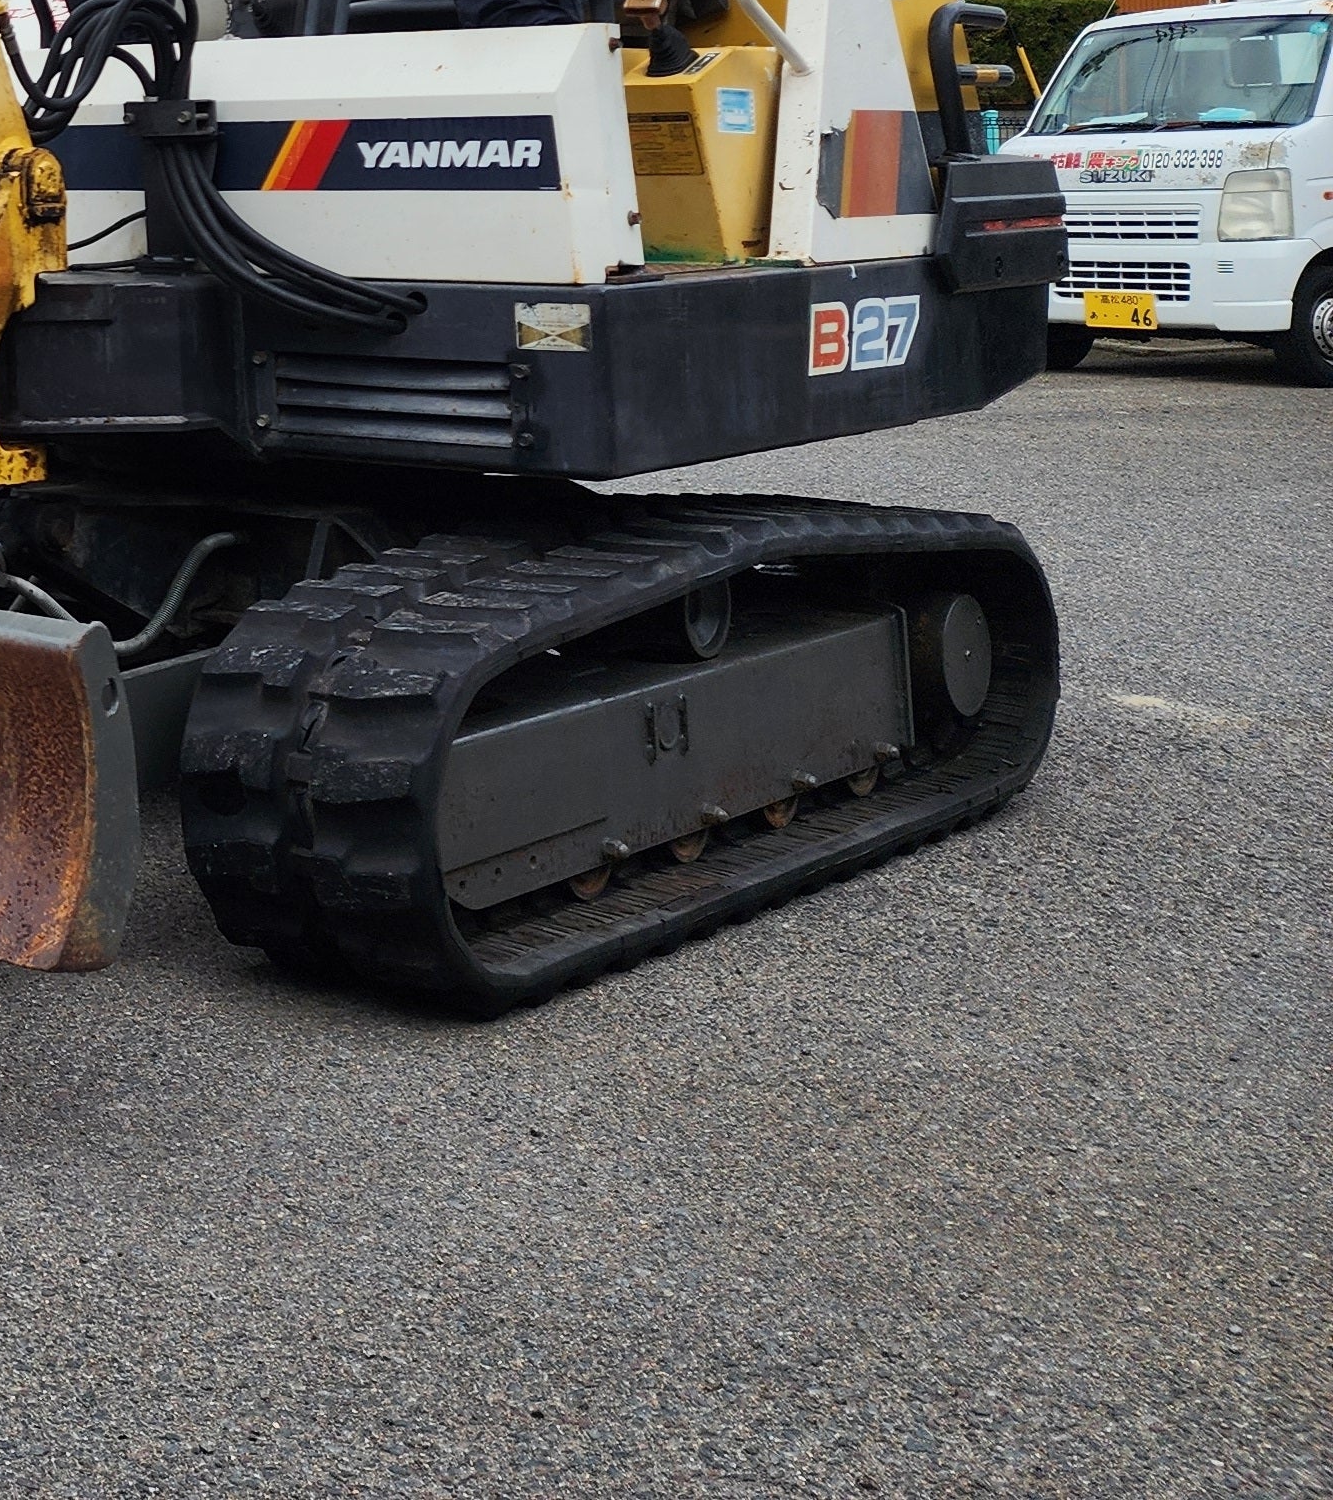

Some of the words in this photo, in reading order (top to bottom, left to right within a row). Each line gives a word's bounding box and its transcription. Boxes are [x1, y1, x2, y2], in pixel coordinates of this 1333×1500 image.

[357, 139, 542, 168] YANMAR
[1080, 169, 1151, 183] SUZUKI
[809, 295, 920, 376] B27
